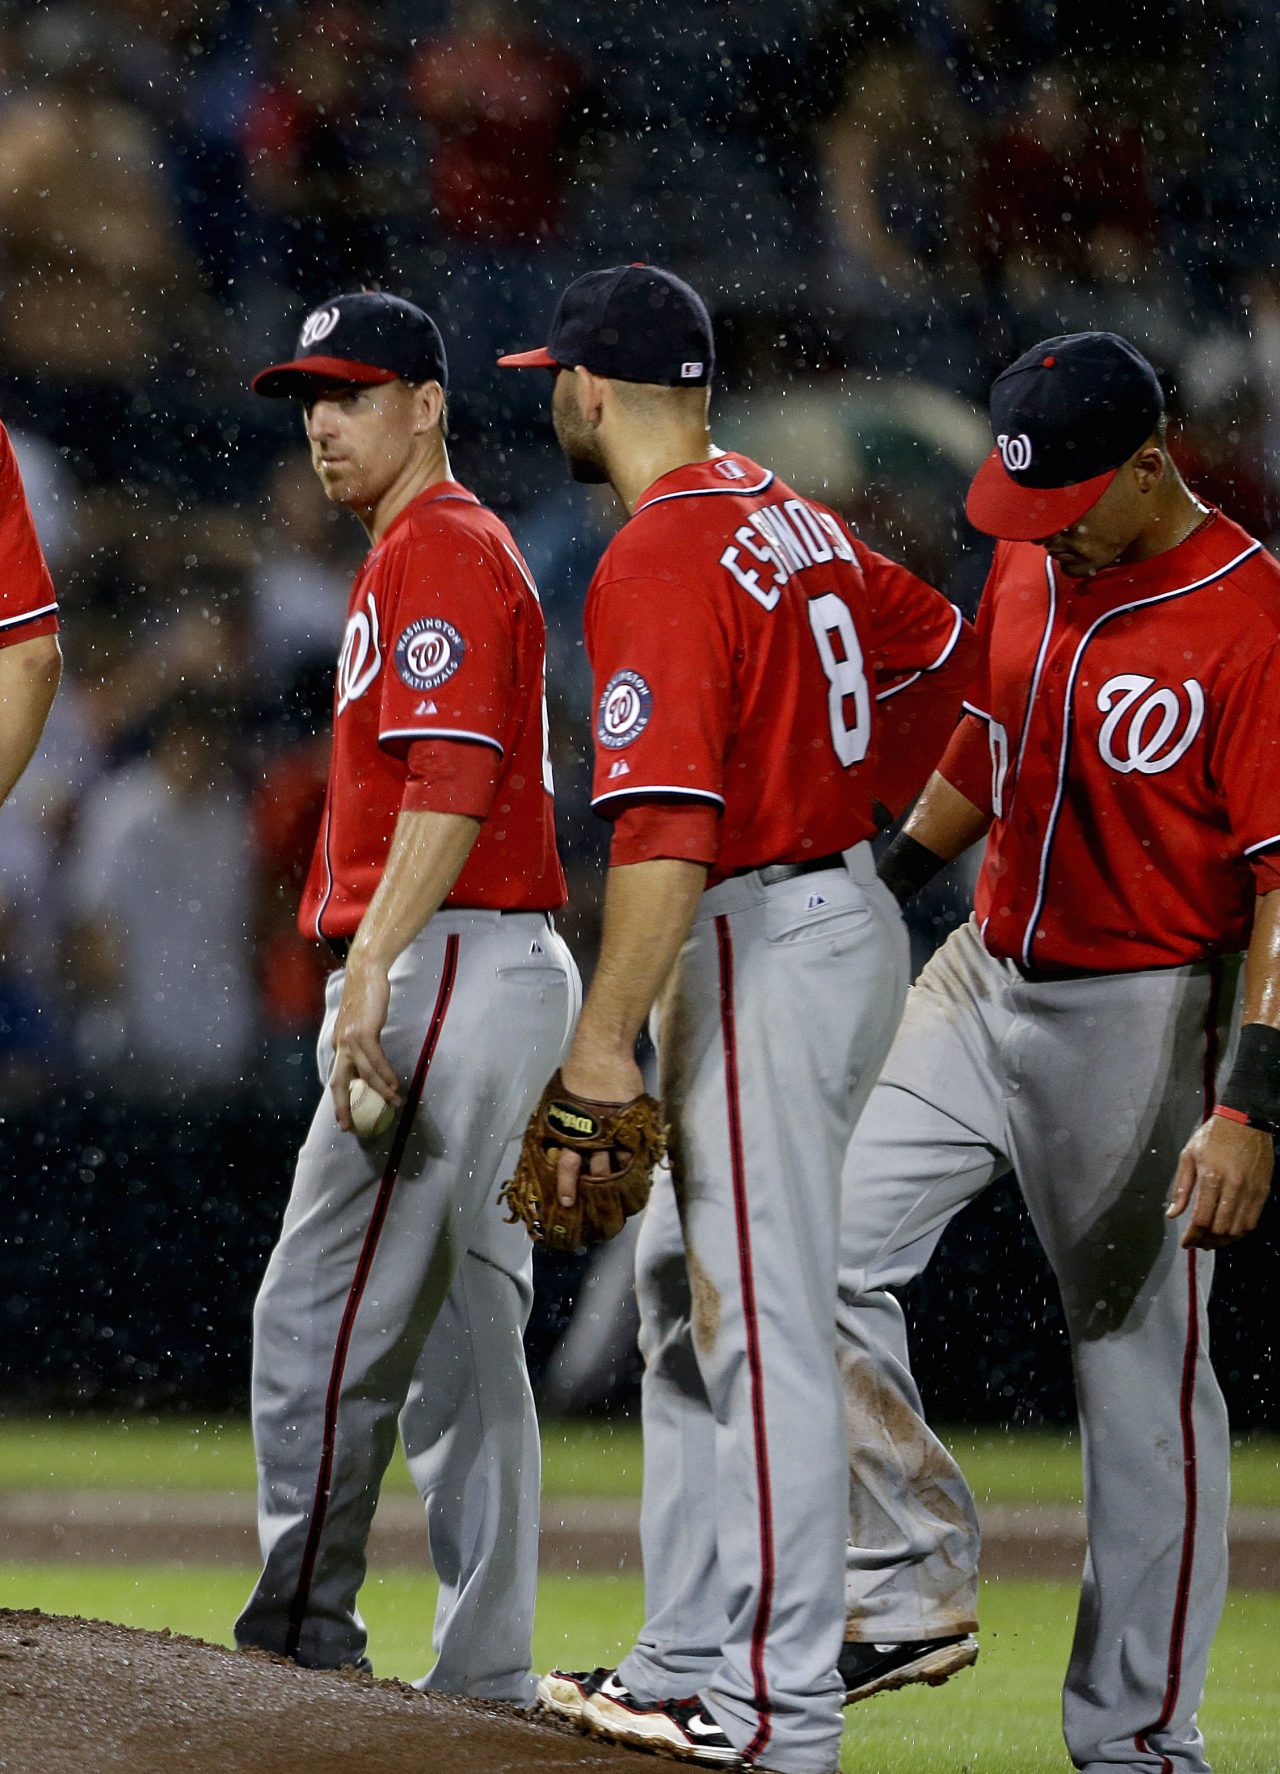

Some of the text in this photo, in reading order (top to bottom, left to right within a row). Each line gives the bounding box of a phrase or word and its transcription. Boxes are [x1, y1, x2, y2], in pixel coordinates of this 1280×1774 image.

[396, 617, 462, 652] WASHINGTON
[401, 661, 459, 689] NATIONALS
[806, 591, 872, 770] 8
[1096, 672, 1206, 775] W
